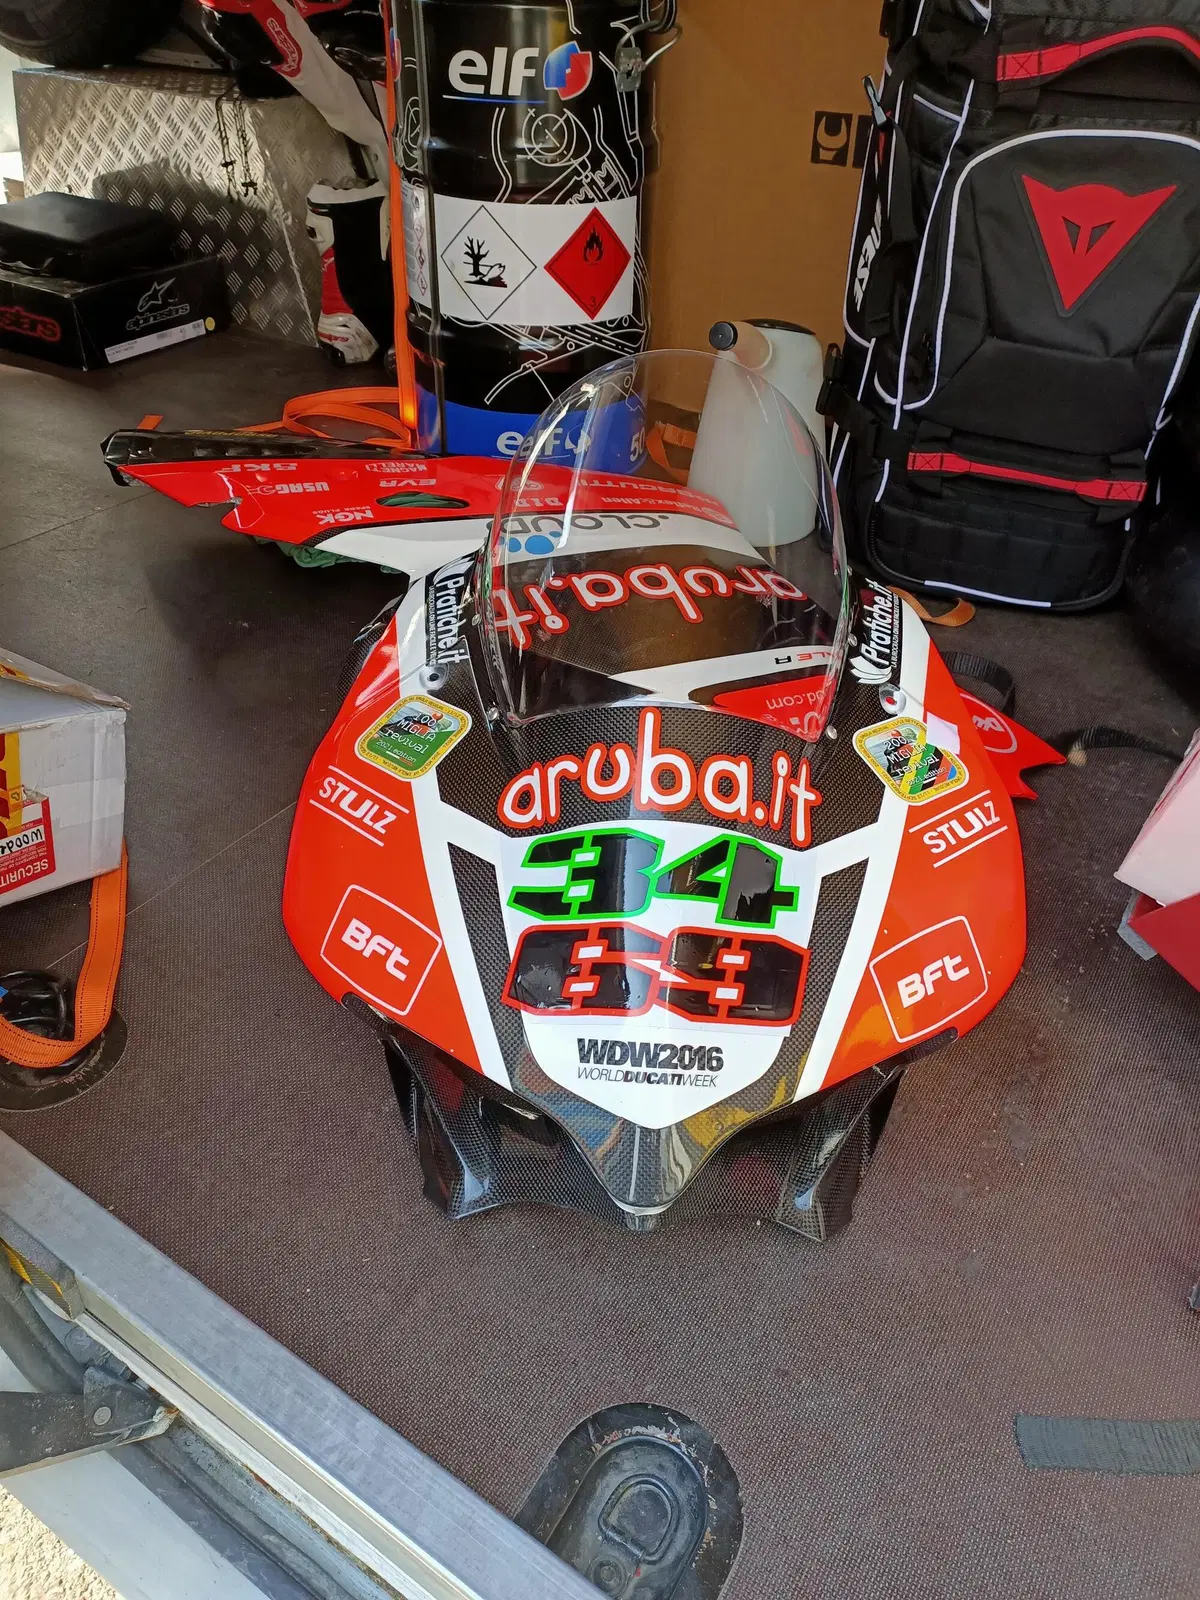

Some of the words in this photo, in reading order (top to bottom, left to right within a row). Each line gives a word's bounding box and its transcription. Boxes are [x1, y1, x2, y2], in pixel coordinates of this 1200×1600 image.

[448, 47, 540, 96] elf
[215, 463, 298, 473] SKF
[276, 481, 330, 495] USAG
[316, 509, 374, 525] NGK
[435, 574, 471, 665] Pratiche.it
[492, 563, 808, 650] aruba.it
[861, 578, 893, 666] Pratiche.it
[384, 728, 429, 754] revival
[397, 719, 436, 742] MIGLIA
[392, 748, 417, 763] edition
[497, 707, 822, 847] aruba.it
[318, 776, 398, 835] STULZ
[922, 800, 1001, 854] STULZ
[507, 827, 800, 929] 34
[577, 1037, 725, 1073] WDW2016
